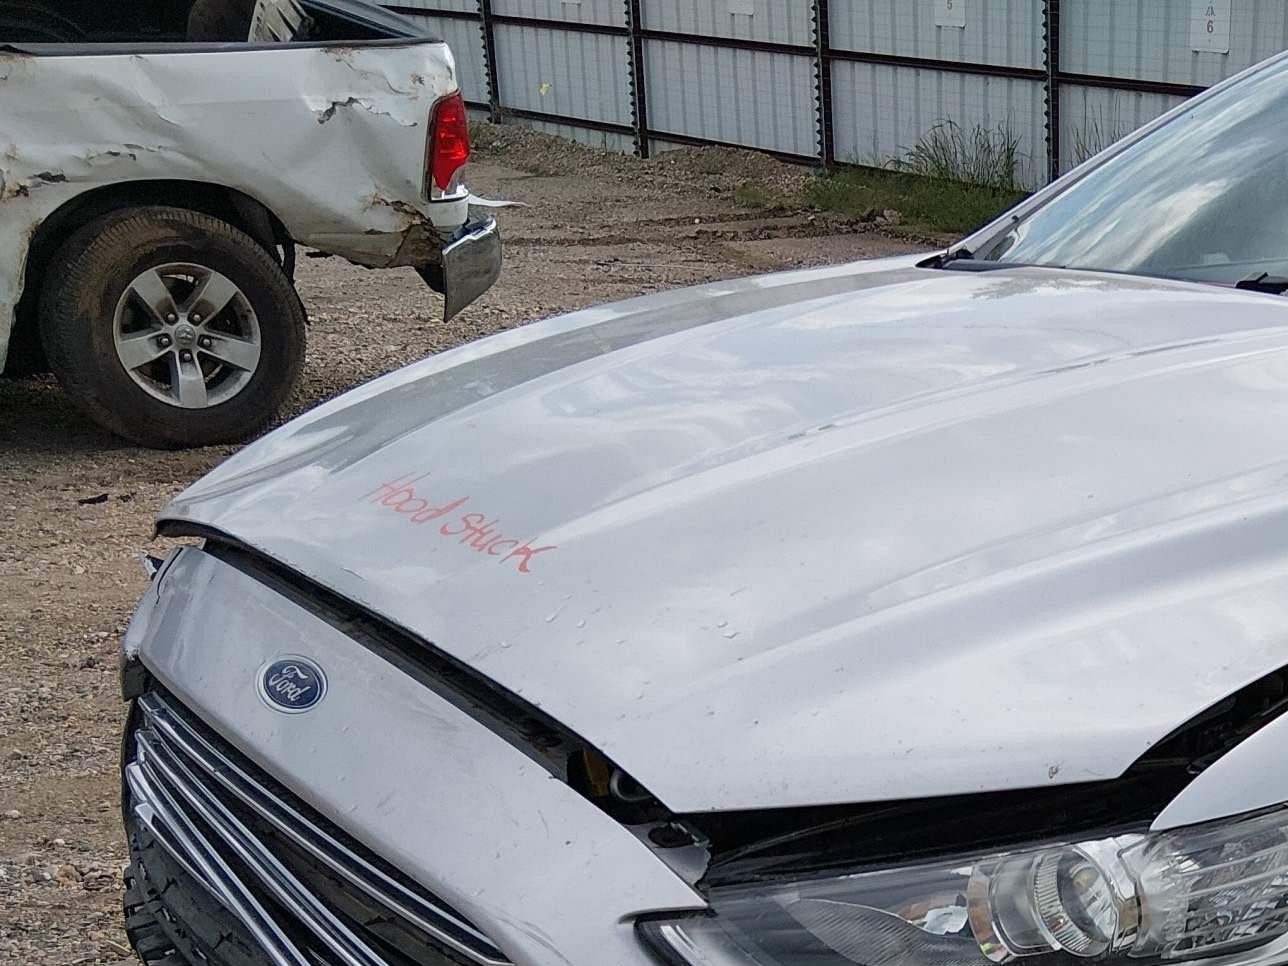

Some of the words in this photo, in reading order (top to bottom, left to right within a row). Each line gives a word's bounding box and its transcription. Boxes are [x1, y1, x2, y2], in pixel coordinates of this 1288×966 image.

[1206, 20, 1214, 34] 6
[359, 471, 470, 524] Hood
[269, 665, 311, 701] Ford
